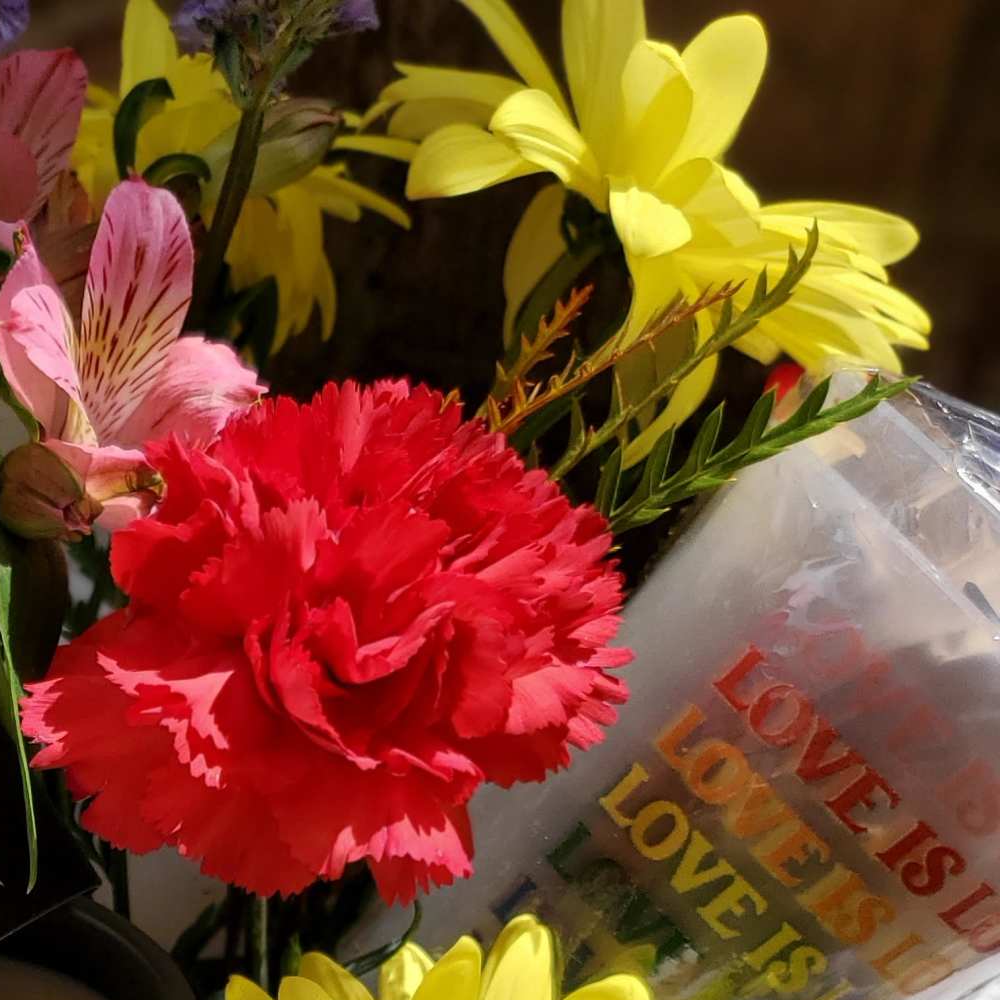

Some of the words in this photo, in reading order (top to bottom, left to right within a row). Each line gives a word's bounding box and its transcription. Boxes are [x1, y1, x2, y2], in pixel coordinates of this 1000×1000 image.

[599, 761, 768, 941] LOVE
[744, 922, 829, 994] IS
[655, 704, 831, 888] LOVE
[802, 862, 896, 945] IS
[713, 644, 902, 835] LOVE
[874, 820, 967, 897] IS
